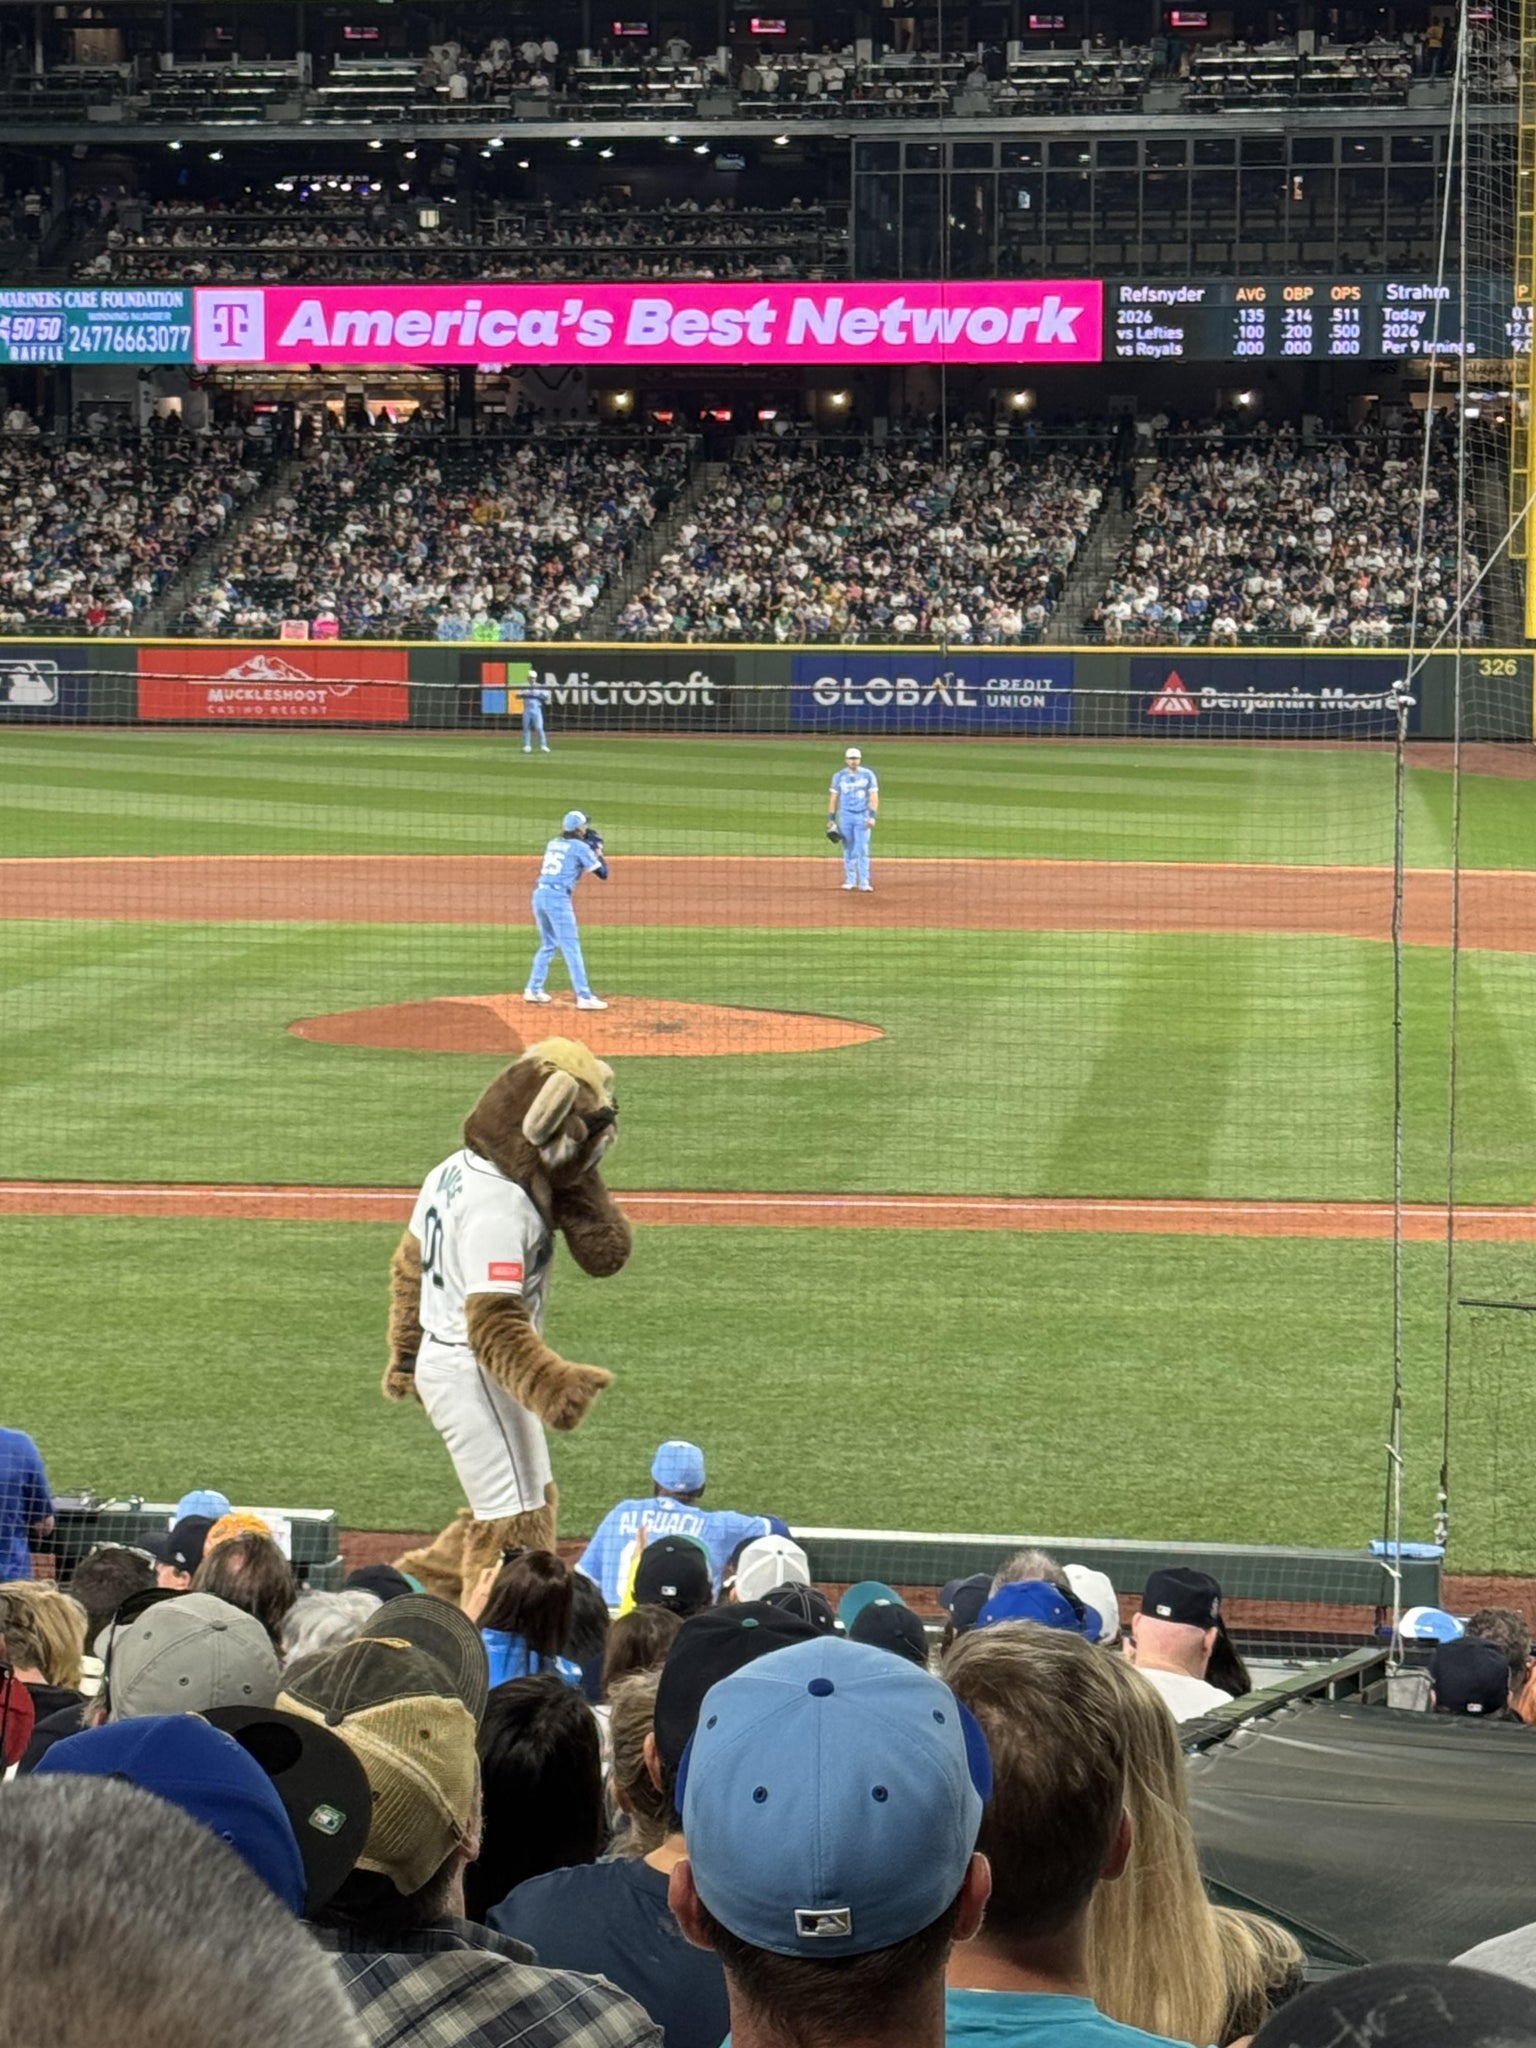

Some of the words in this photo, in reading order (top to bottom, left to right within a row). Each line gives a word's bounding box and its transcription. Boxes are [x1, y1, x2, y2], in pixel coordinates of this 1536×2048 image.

[64, 291, 98, 308] CARE
[101, 291, 184, 308] FOUNDATION
[1120, 286, 1205, 305] Refsnyder
[1236, 287, 1266, 301] AVG
[1283, 286, 1314, 301] OBP
[1330, 286, 1361, 301] OPS
[277, 299, 614, 347] America's
[625, 298, 776, 346] Best
[786, 295, 1083, 345] Network
[1117, 310, 1153, 323] 2026
[1233, 309, 1265, 323] .135
[1281, 308, 1312, 322] .214
[1328, 308, 1359, 322] .511
[1382, 307, 1426, 324] Today
[68, 325, 192, 352] 24776663077
[1116, 329, 1133, 339] vs
[1136, 326, 1184, 340] Lefties
[1233, 325, 1265, 339] .100
[1281, 324, 1312, 339] .200
[1328, 324, 1360, 339] .500
[1382, 323, 1419, 338] 2026
[10, 346, 64, 360] RAFFLE
[1116, 344, 1134, 356] vs
[1136, 342, 1183, 359] Royals
[1233, 341, 1265, 355] .000
[1280, 341, 1312, 355] .000
[1328, 340, 1360, 355] .000
[1382, 340, 1408, 354] Per
[1410, 340, 1421, 354] 9
[1479, 660, 1518, 676] 326
[544, 671, 715, 706] Microsoft
[812, 676, 977, 707] GLOBAL
[986, 679, 1053, 692] CREDIT
[208, 688, 327, 703] MUCKLESHOOT
[986, 694, 1046, 707] UNION
[1200, 686, 1314, 714] Benjamin
